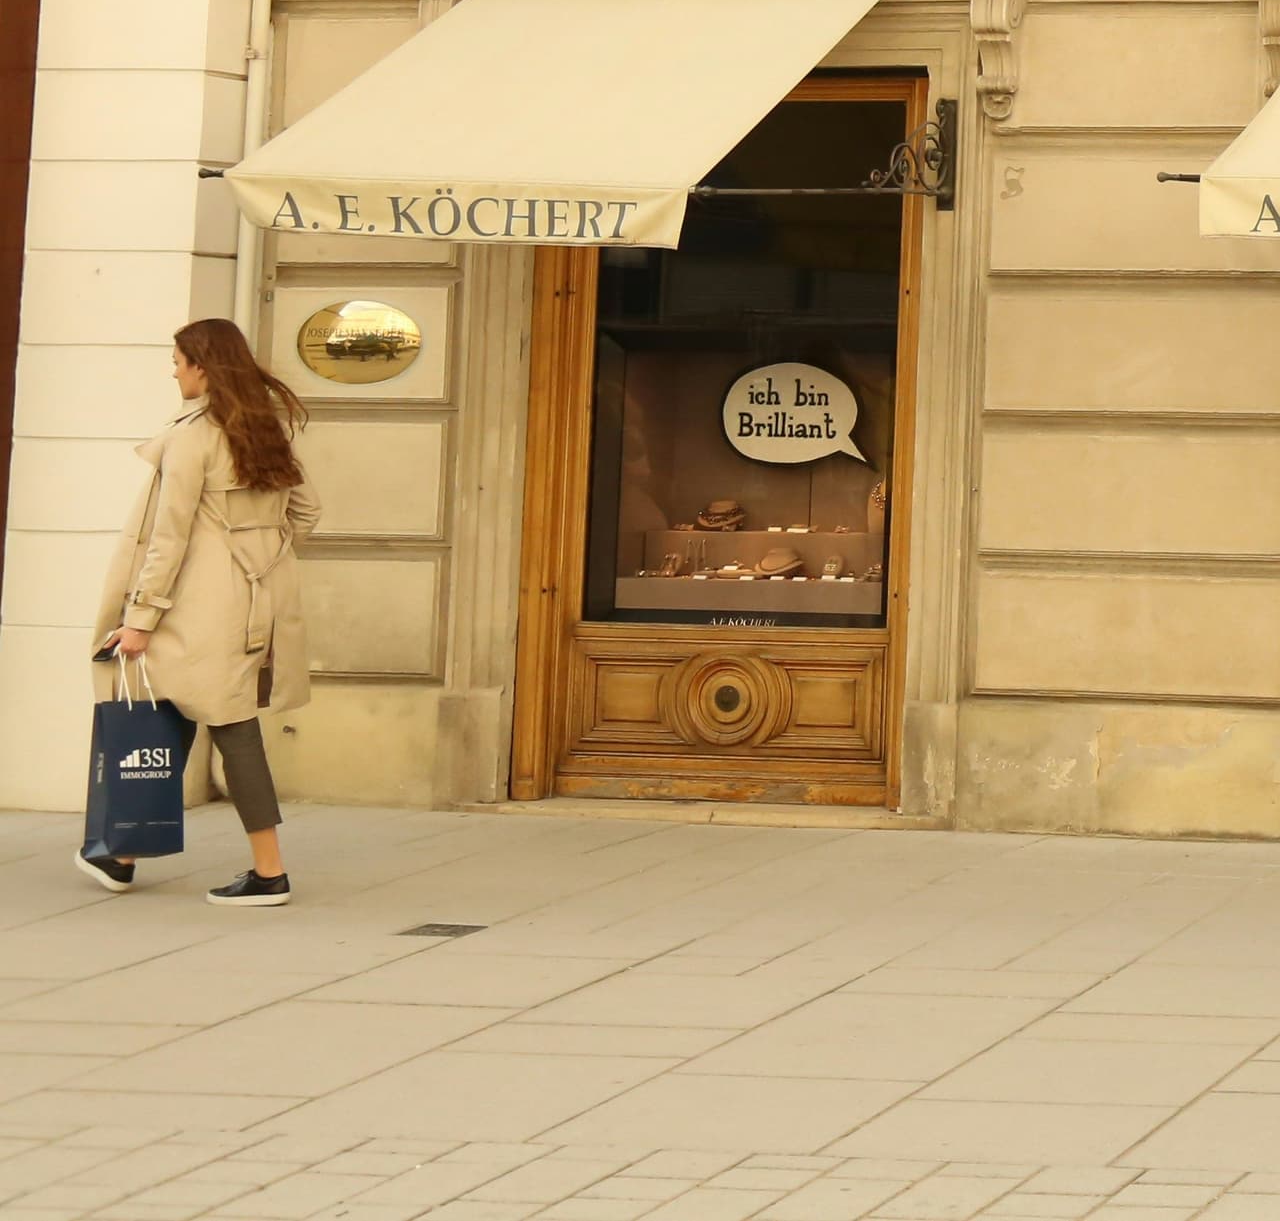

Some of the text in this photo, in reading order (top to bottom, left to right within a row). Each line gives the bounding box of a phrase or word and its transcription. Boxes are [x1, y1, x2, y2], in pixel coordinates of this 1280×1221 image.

[271, 188, 638, 239] A. E. KÖCHERT
[748, 378, 829, 407] ich bin
[737, 412, 837, 439] Brilliant
[141, 748, 171, 768] 3SI
[120, 771, 172, 780] IMMOGROUP
